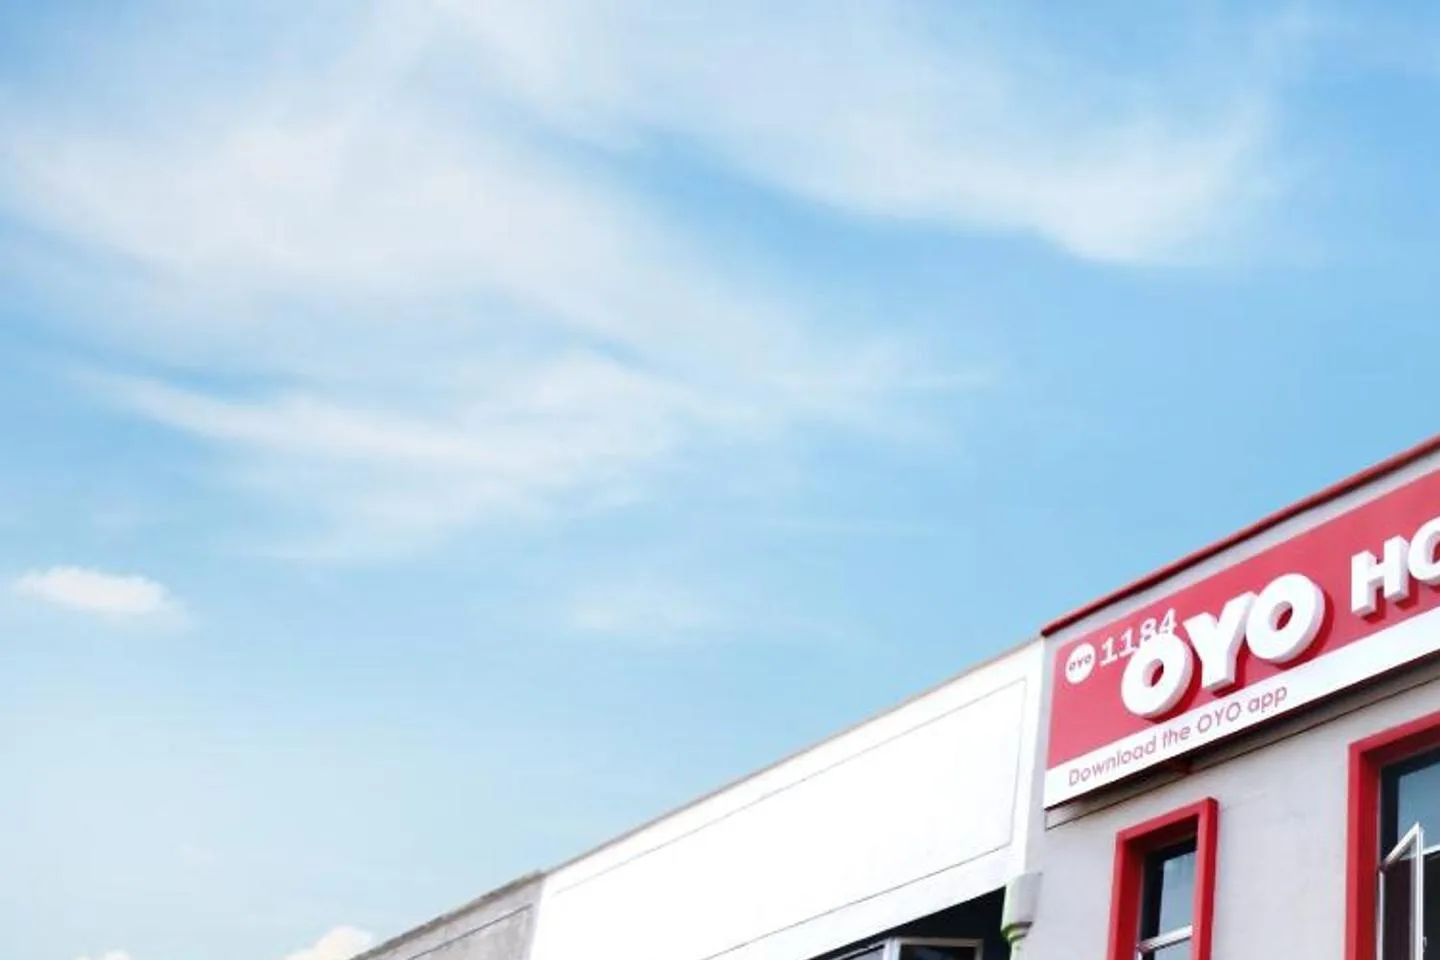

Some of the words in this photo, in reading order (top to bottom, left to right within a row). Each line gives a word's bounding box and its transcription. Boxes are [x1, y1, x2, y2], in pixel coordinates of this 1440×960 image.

[1100, 607, 1178, 667] 1184
[1121, 573, 1326, 719] OYO
[1067, 734, 1158, 787] Download
[1162, 726, 1191, 749] the
[1196, 702, 1241, 734] OYO
[1247, 685, 1288, 714] app
